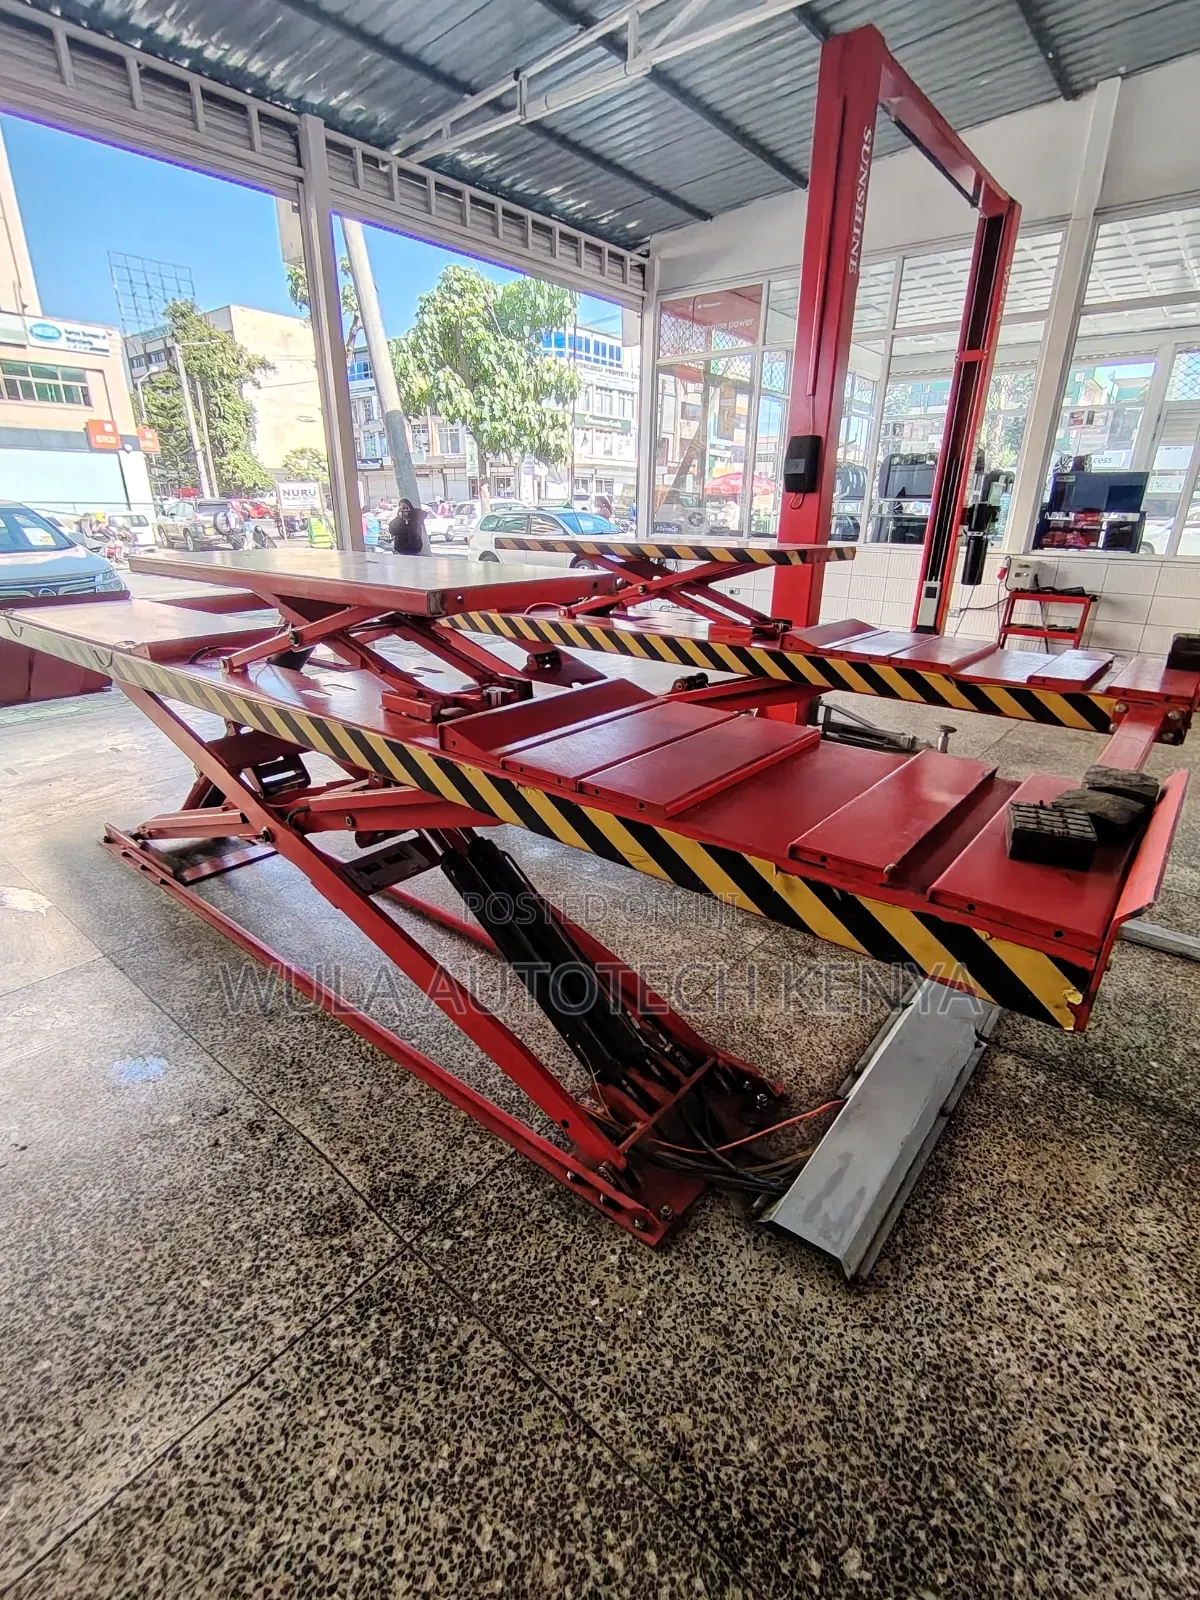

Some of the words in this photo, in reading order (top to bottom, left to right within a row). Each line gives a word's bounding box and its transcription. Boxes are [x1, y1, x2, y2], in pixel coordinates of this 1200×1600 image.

[848, 125, 872, 274] SUNSHINE
[729, 318, 755, 331] power
[282, 489, 316, 497] NURU
